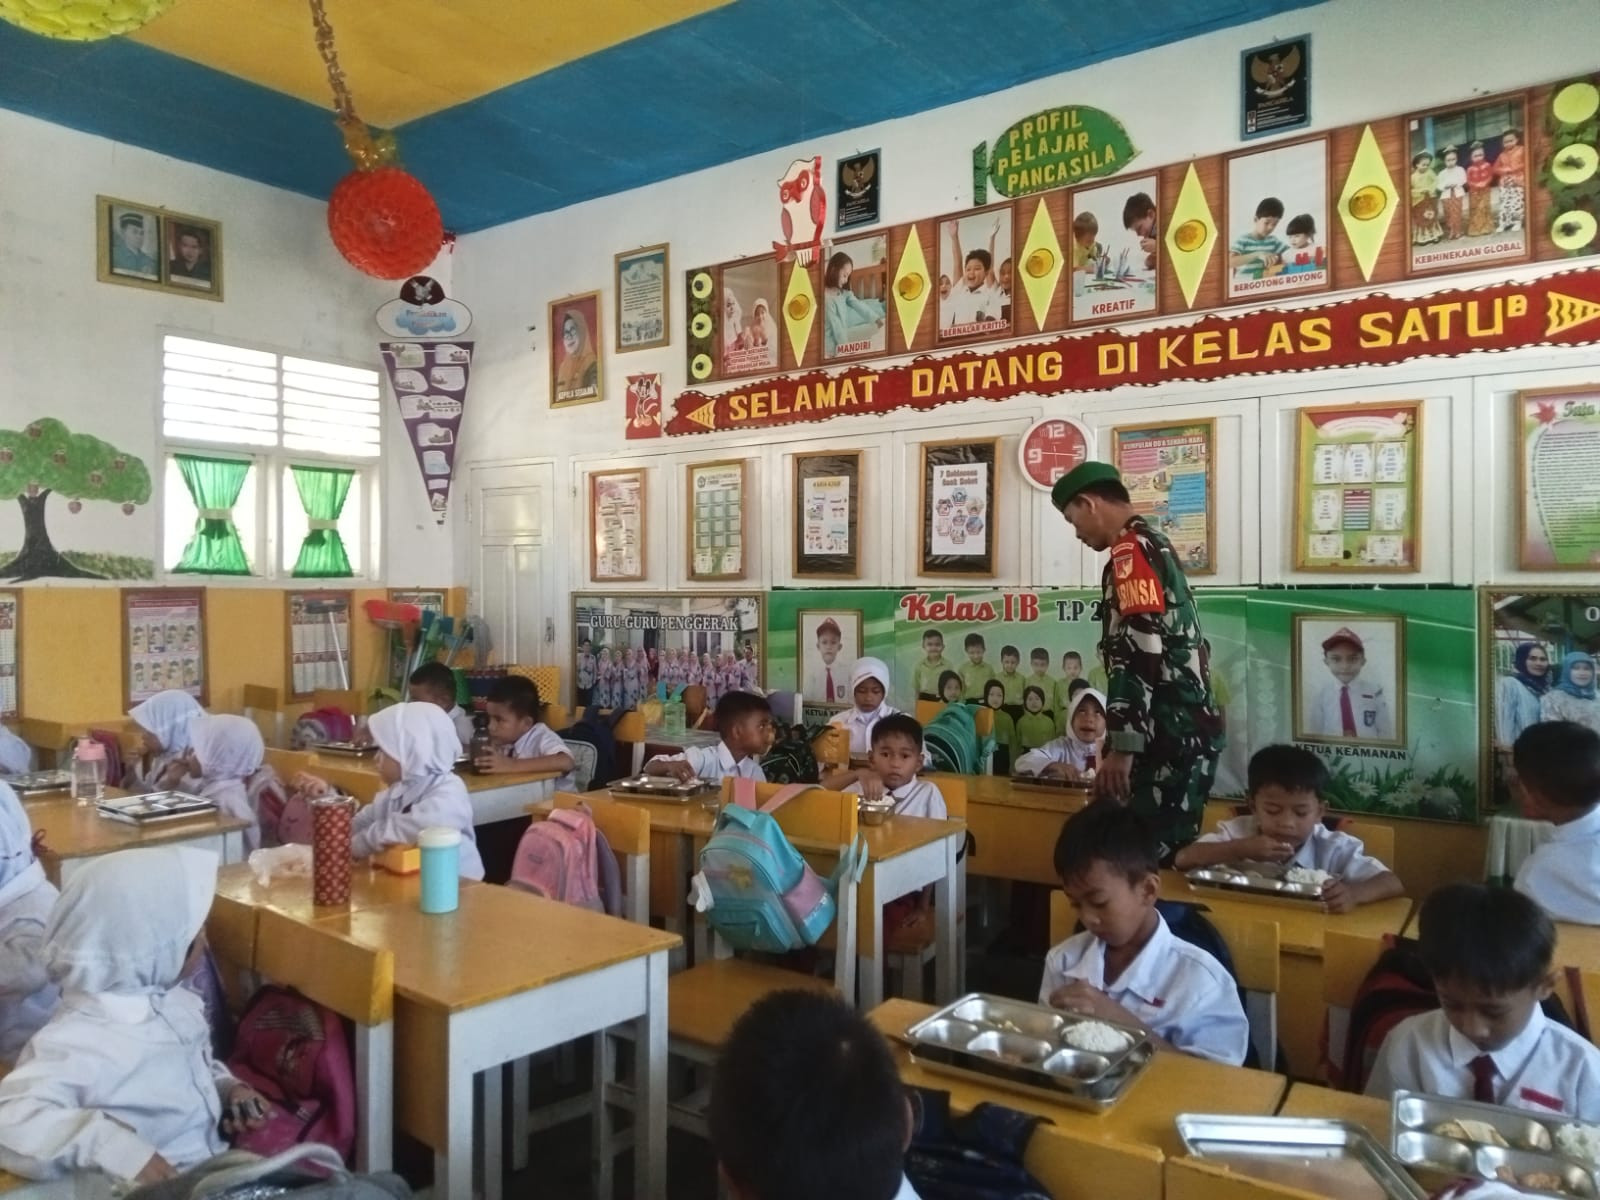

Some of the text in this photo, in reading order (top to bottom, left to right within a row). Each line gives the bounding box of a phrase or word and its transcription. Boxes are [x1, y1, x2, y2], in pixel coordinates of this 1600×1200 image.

[1009, 110, 1082, 148] PROFIL
[998, 132, 1089, 176] PELAJAR
[1007, 144, 1116, 192] PANCASILA
[1415, 242, 1522, 264] KEBHINEKAAN GLOBAL
[1234, 272, 1323, 292] BERGOTONG ROYONG
[1092, 298, 1136, 315] KREATIF
[836, 341, 872, 354] MANDIRI
[728, 374, 879, 421] SELAMAT
[911, 351, 1063, 398] DATANG
[1098, 341, 1138, 376] DI
[1159, 317, 1332, 370] KELAS
[1047, 423, 1065, 438] 12
[1028, 448, 1042, 464] 9
[1072, 444, 1085, 460] 3
[1116, 578, 1160, 611] BINSA
[900, 594, 996, 622] Kelas
[1055, 600, 1086, 622] T.P
[660, 615, 739, 631] PENGGERAK
[805, 708, 829, 717] KETUA
[1335, 746, 1407, 761] KEAMANAN
